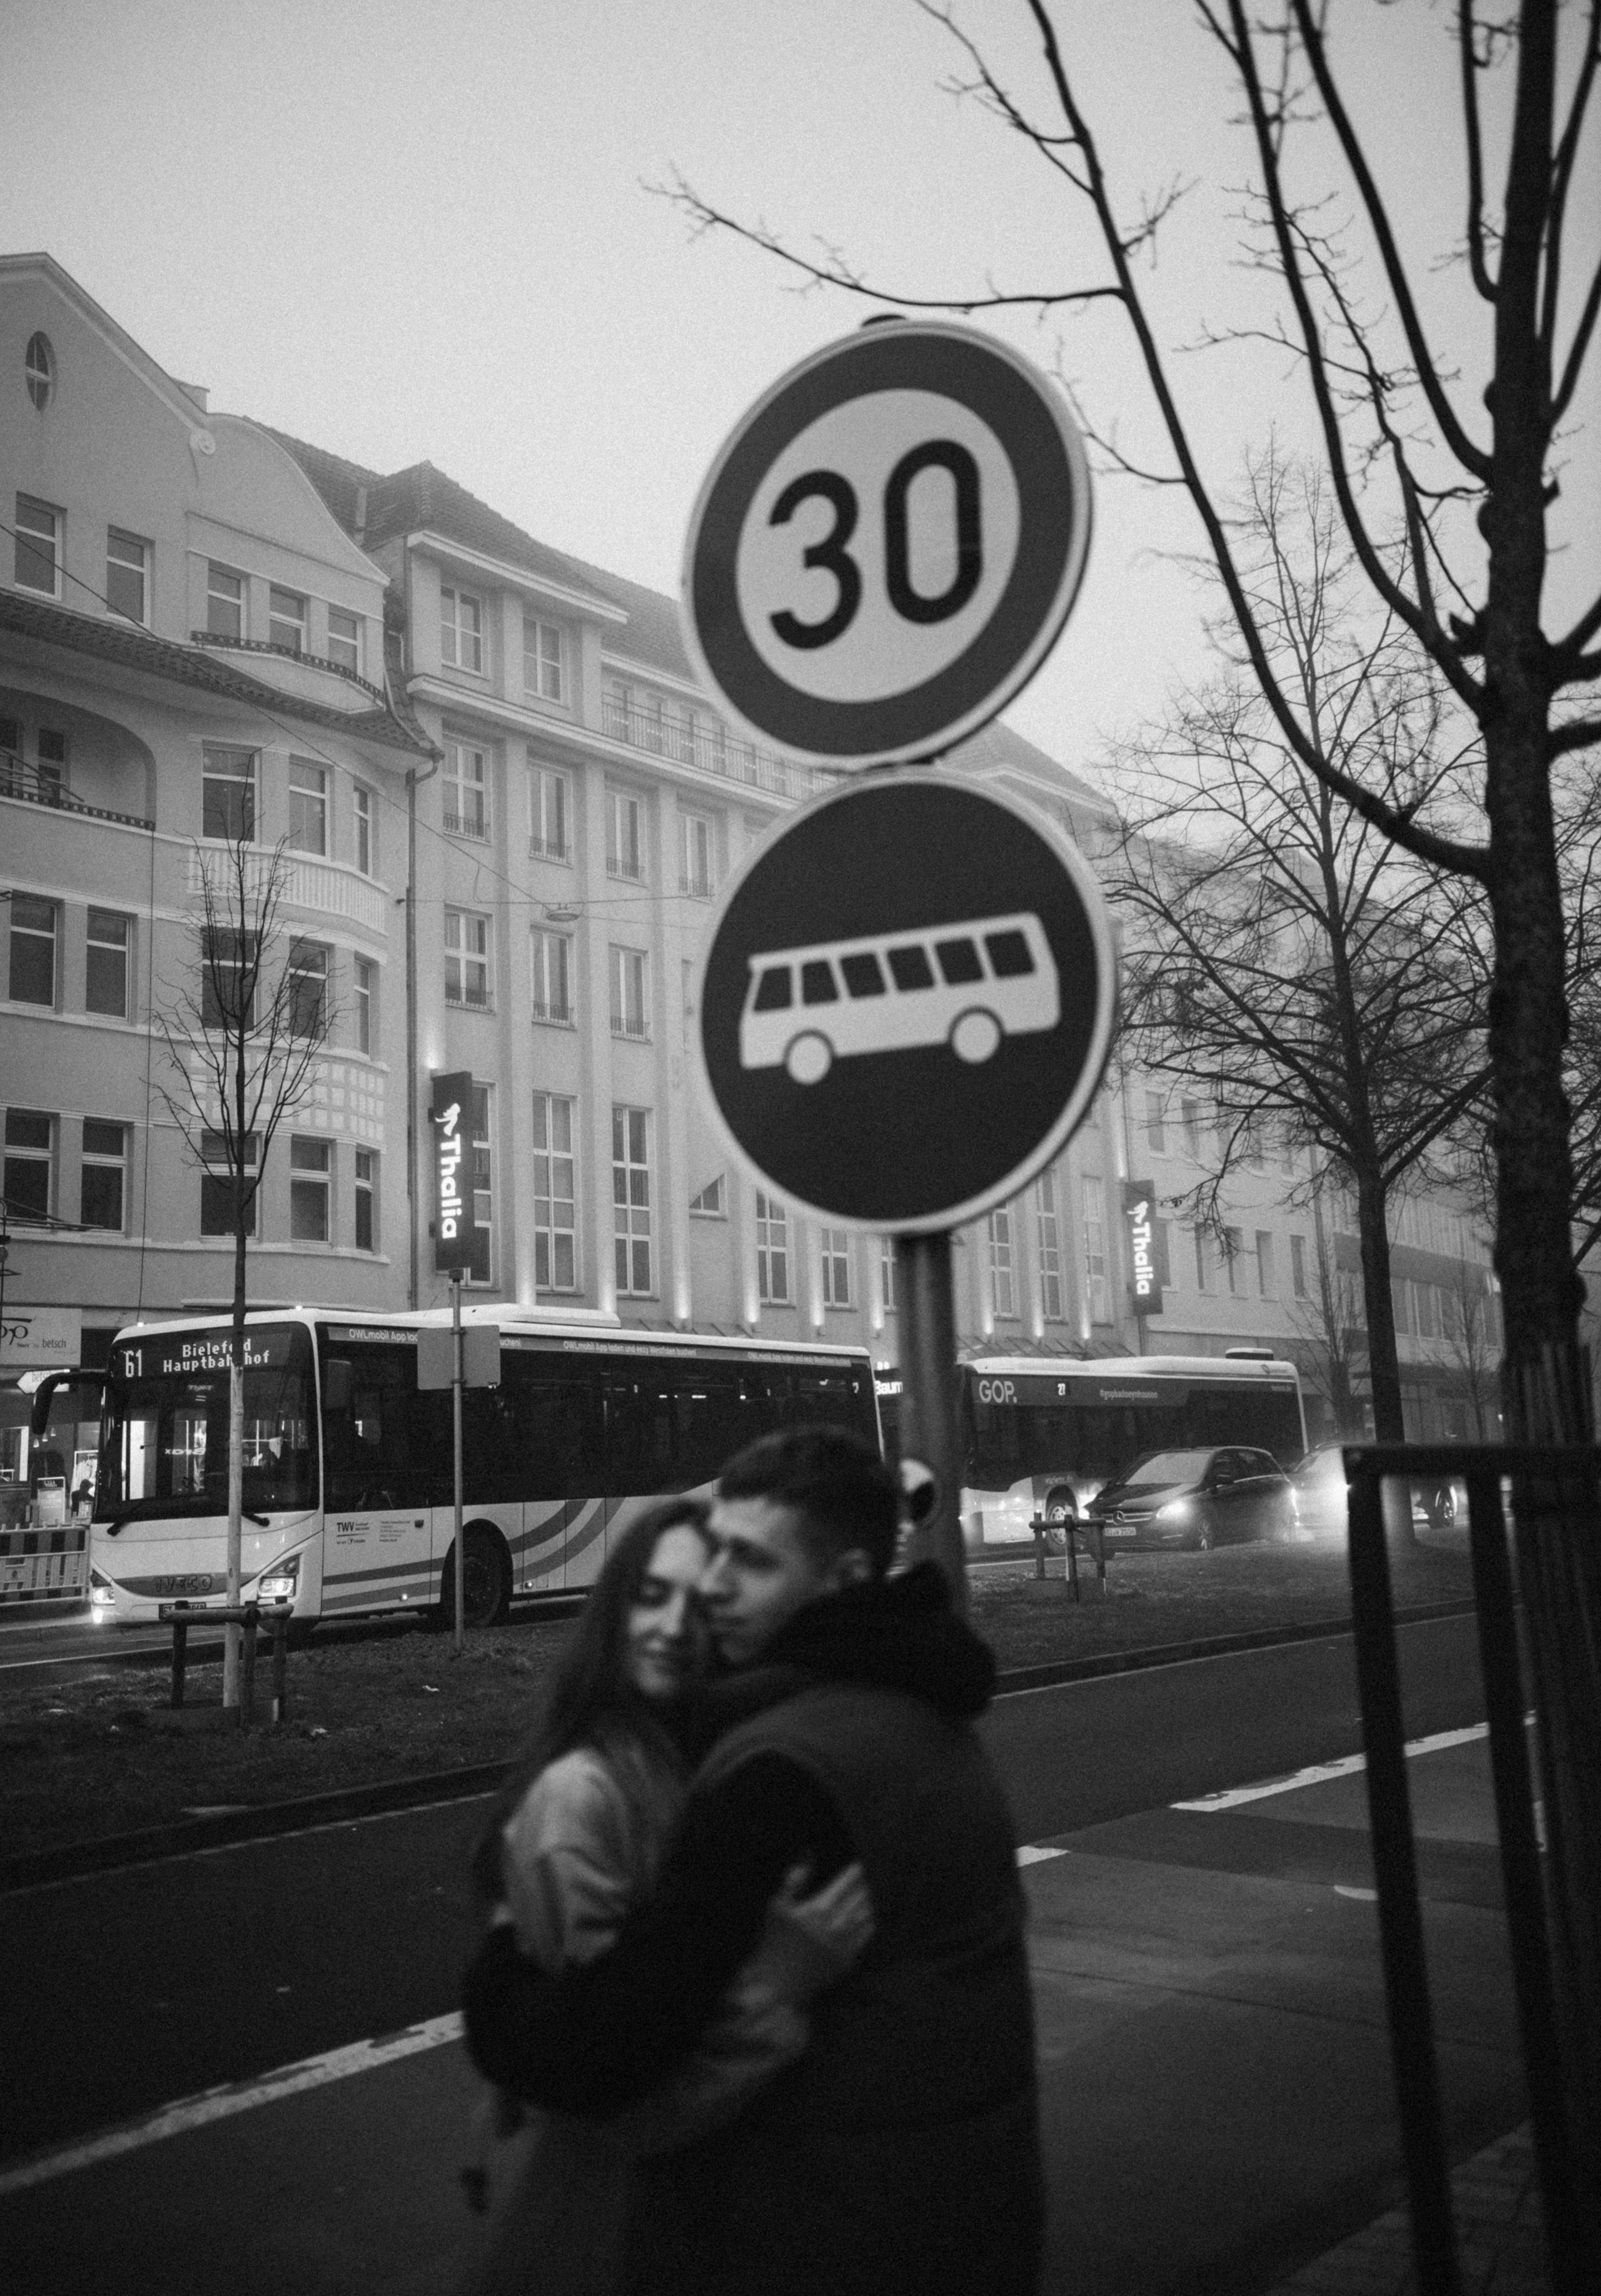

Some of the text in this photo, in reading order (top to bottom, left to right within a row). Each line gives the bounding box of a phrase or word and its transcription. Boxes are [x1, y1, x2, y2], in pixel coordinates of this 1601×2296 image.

[769, 439, 983, 651] 30
[440, 1133, 462, 1238] Thalia
[1133, 1222, 1154, 1295] Thalia
[42, 1338, 66, 1348] betsch
[349, 1328, 389, 1341] OWLmobil
[391, 1330, 406, 1343] App
[500, 1337, 522, 1347] uchen!
[183, 1338, 251, 1357] Bielefd
[126, 1349, 142, 1378] 61
[163, 1350, 270, 1373] Hauptbahhof
[979, 1380, 1018, 1403] GOP.
[336, 1522, 355, 1532] TWV
